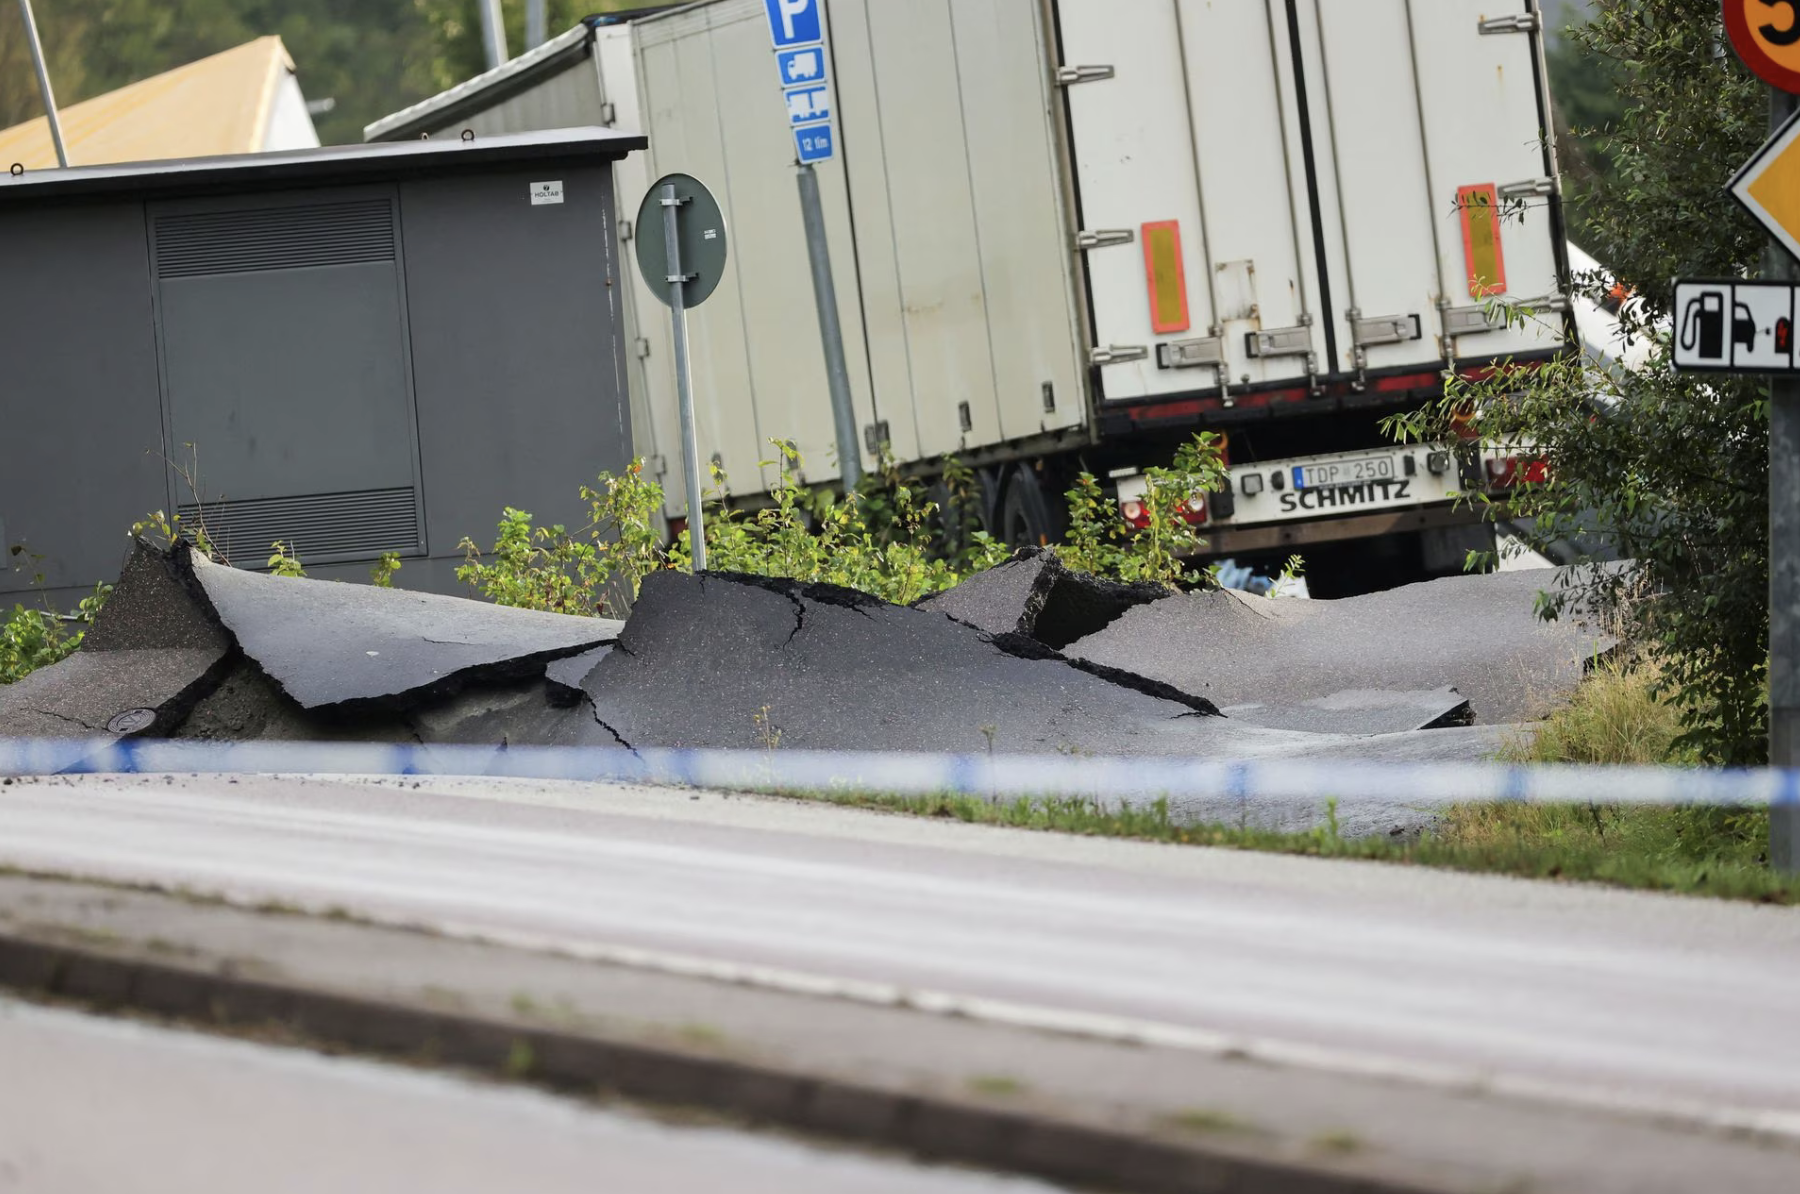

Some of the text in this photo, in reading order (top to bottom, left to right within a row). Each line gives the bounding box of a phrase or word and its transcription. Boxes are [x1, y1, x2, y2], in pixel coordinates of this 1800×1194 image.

[777, 0, 809, 39] P
[802, 138, 813, 151] 12
[1305, 460, 1388, 484] TDP 250
[1279, 480, 1411, 512] SCHMITZ
